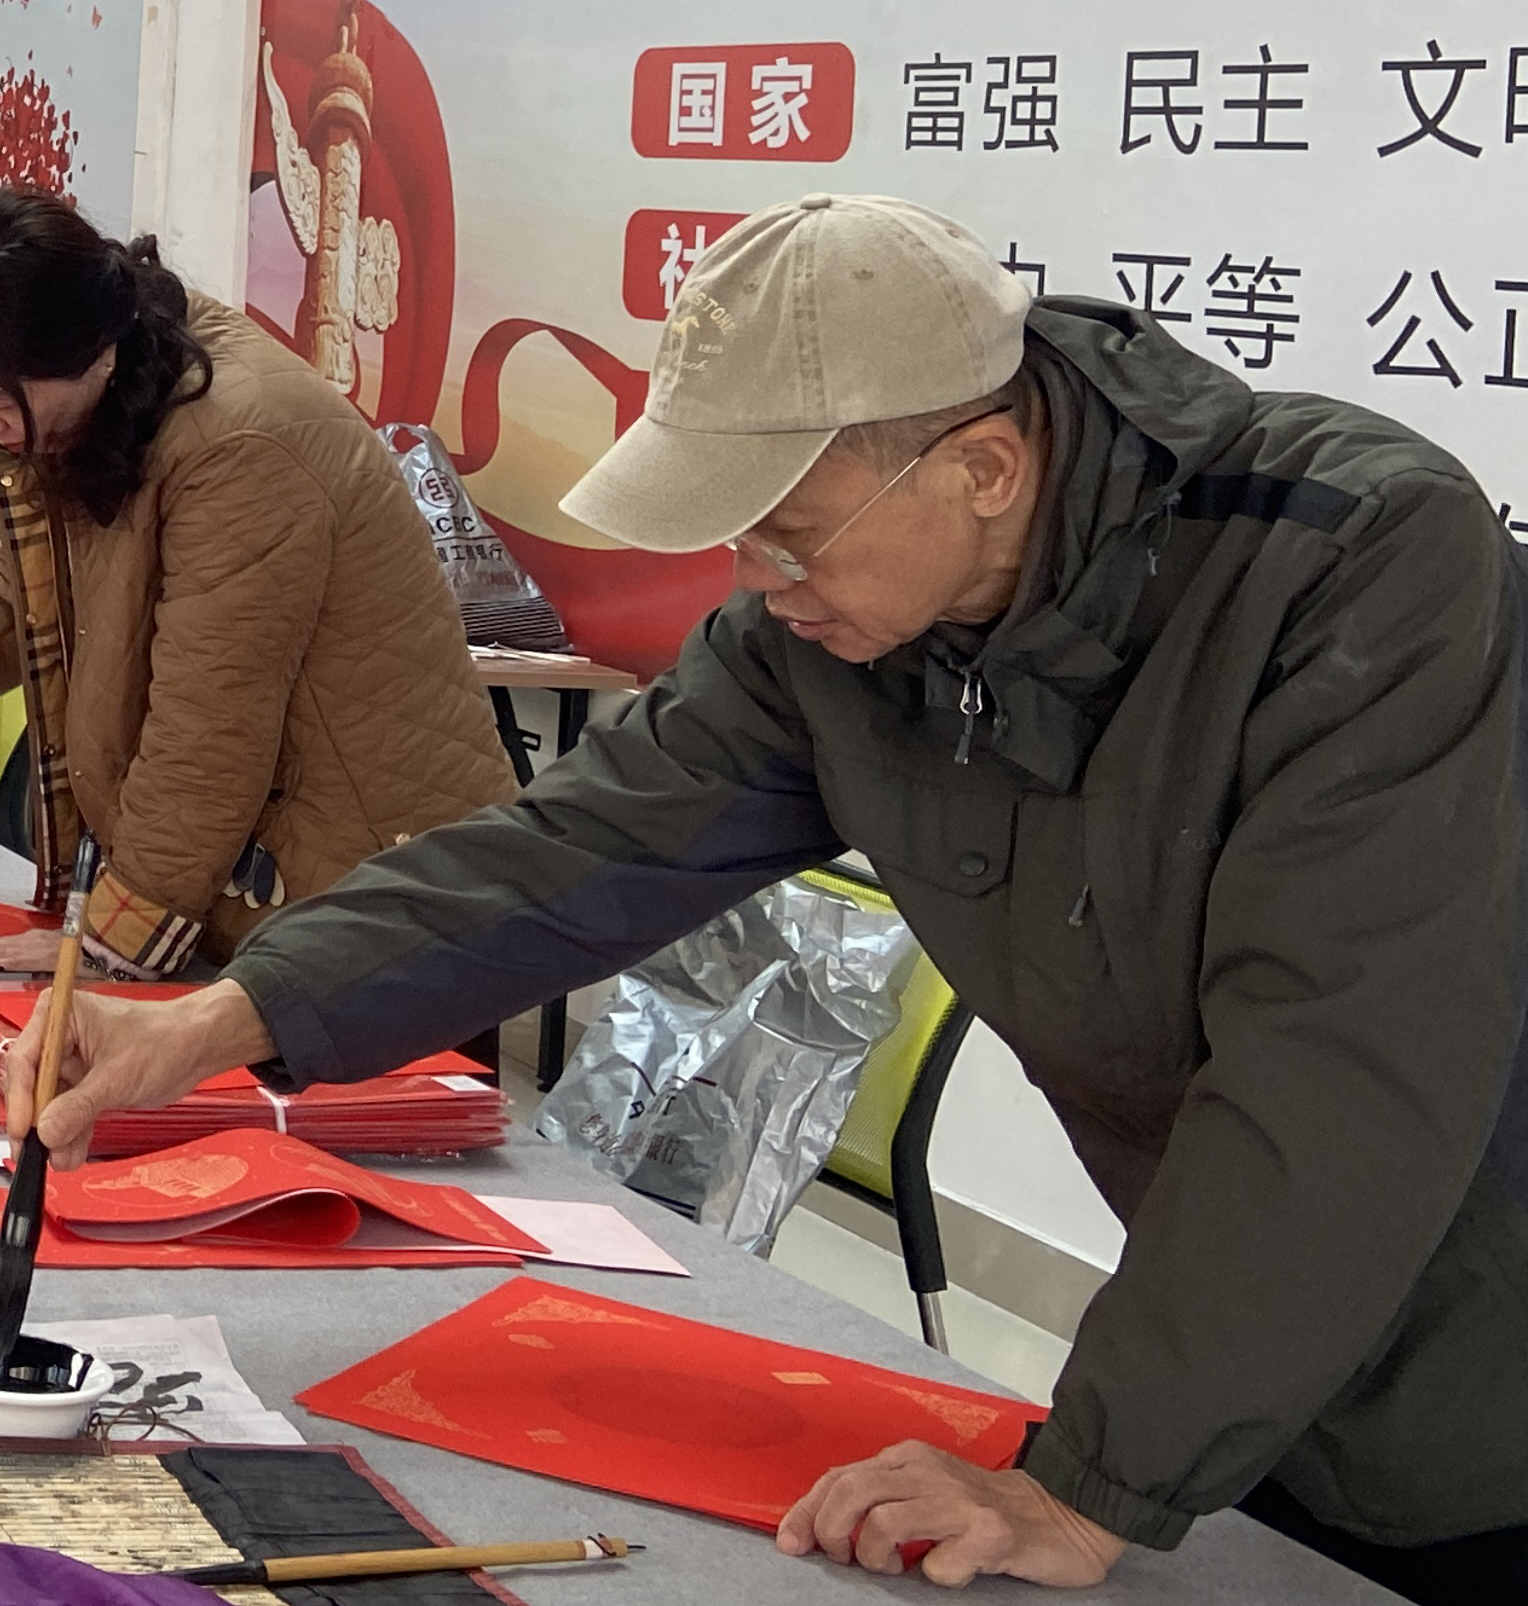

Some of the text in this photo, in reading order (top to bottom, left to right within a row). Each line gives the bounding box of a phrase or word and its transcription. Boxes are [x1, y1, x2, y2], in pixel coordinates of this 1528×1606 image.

[668, 39, 1528, 158] 国家 富强 民主 文
[1113, 252, 1301, 369] 平等
